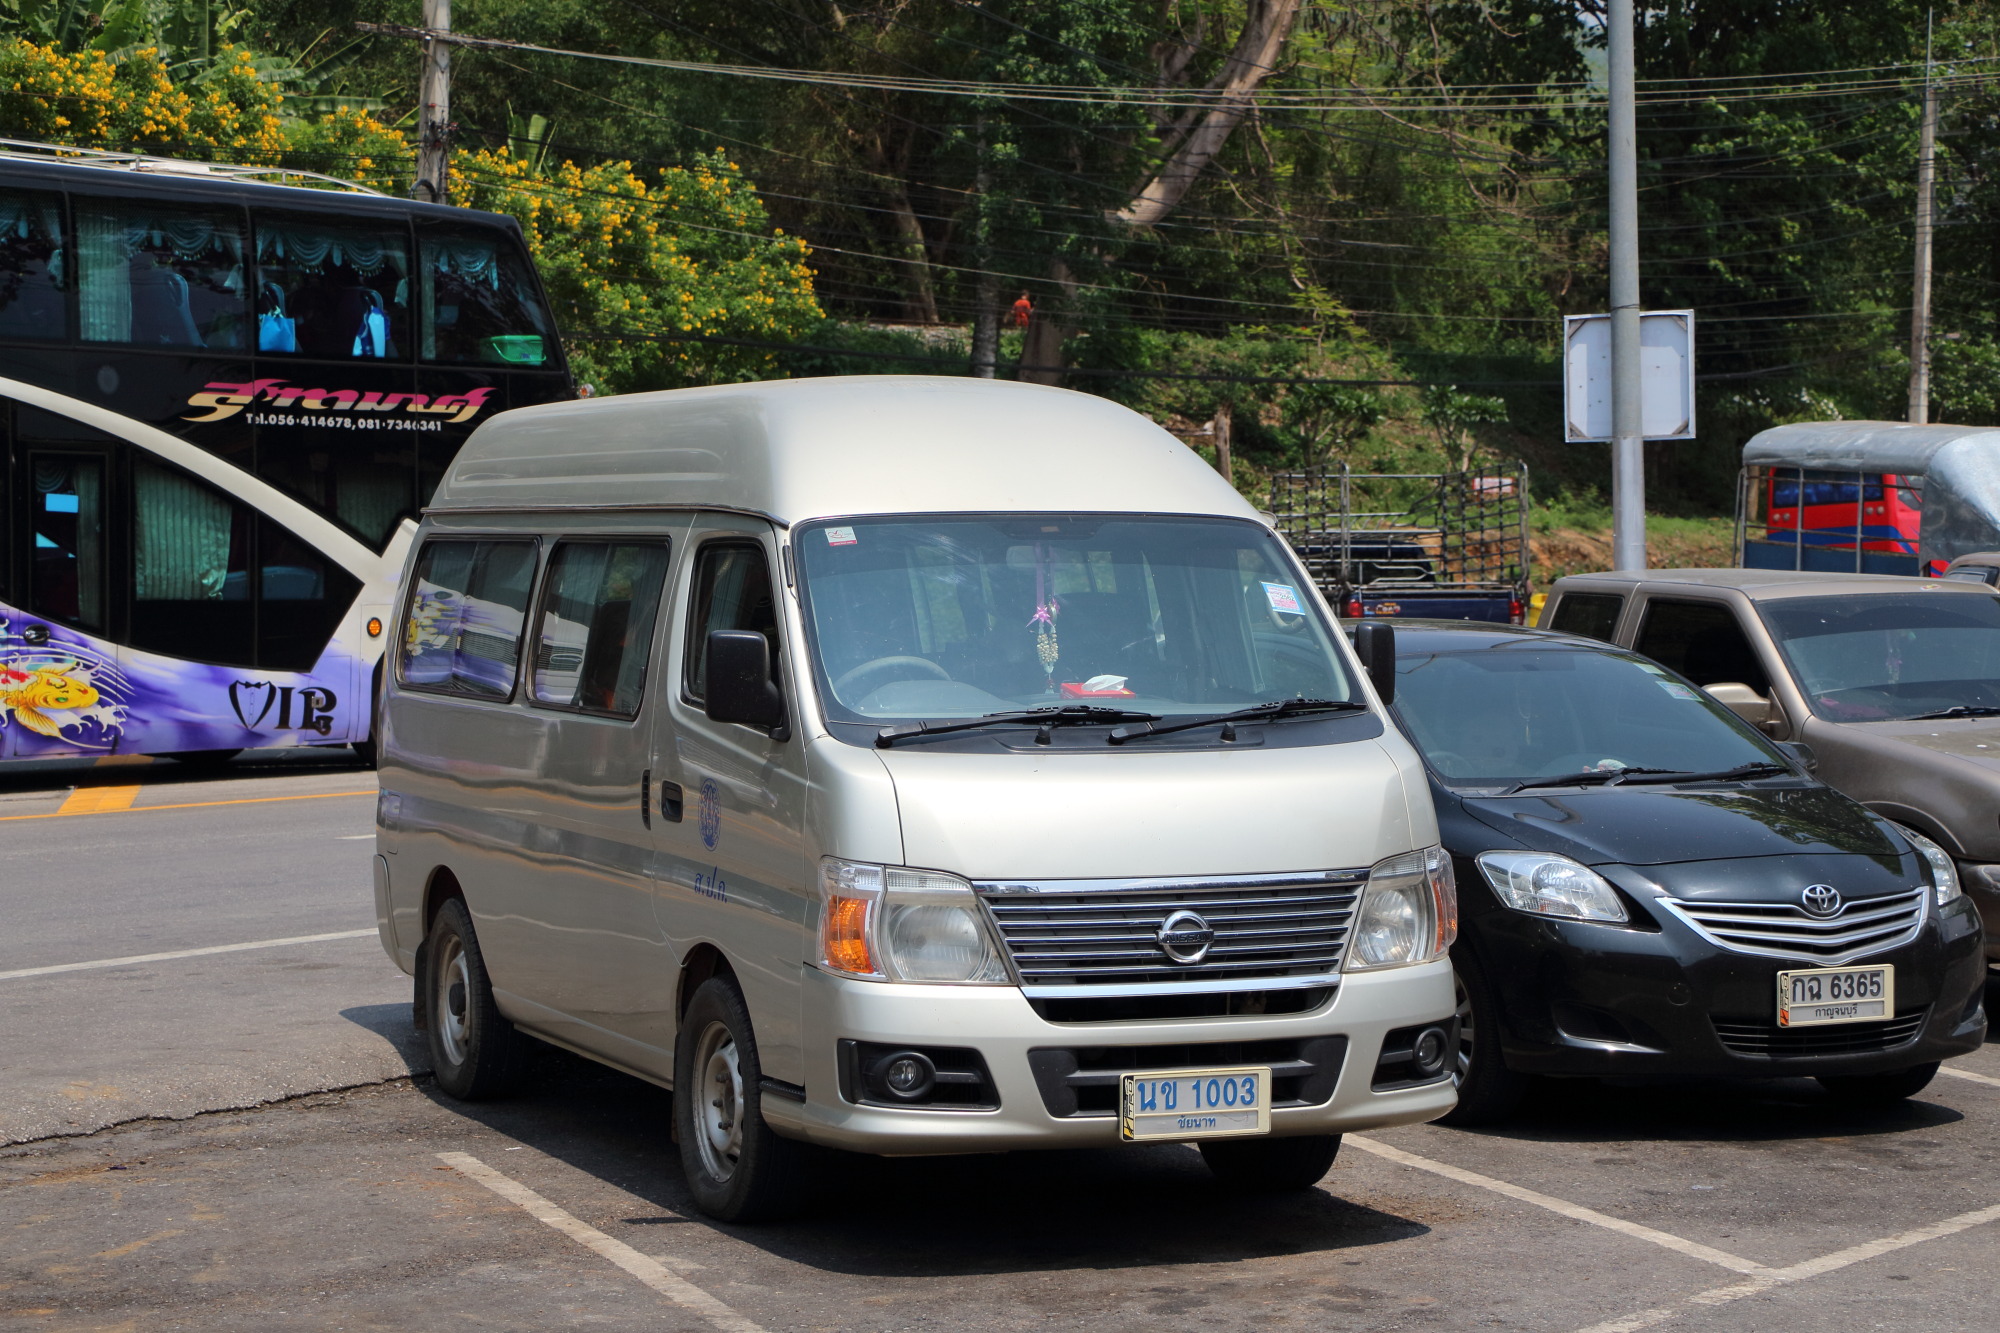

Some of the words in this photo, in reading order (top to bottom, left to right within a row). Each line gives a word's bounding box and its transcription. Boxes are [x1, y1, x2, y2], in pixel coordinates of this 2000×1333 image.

[229, 680, 338, 736] VIP
[1792, 976, 1822, 1002] กฉ
[1830, 972, 1881, 999] 6365
[1815, 1003, 1858, 1019] กาญจนบุรี
[1137, 1080, 1178, 1111] นข
[1192, 1077, 1255, 1108] 1003
[1177, 1115, 1216, 1129] ชัยนาท
